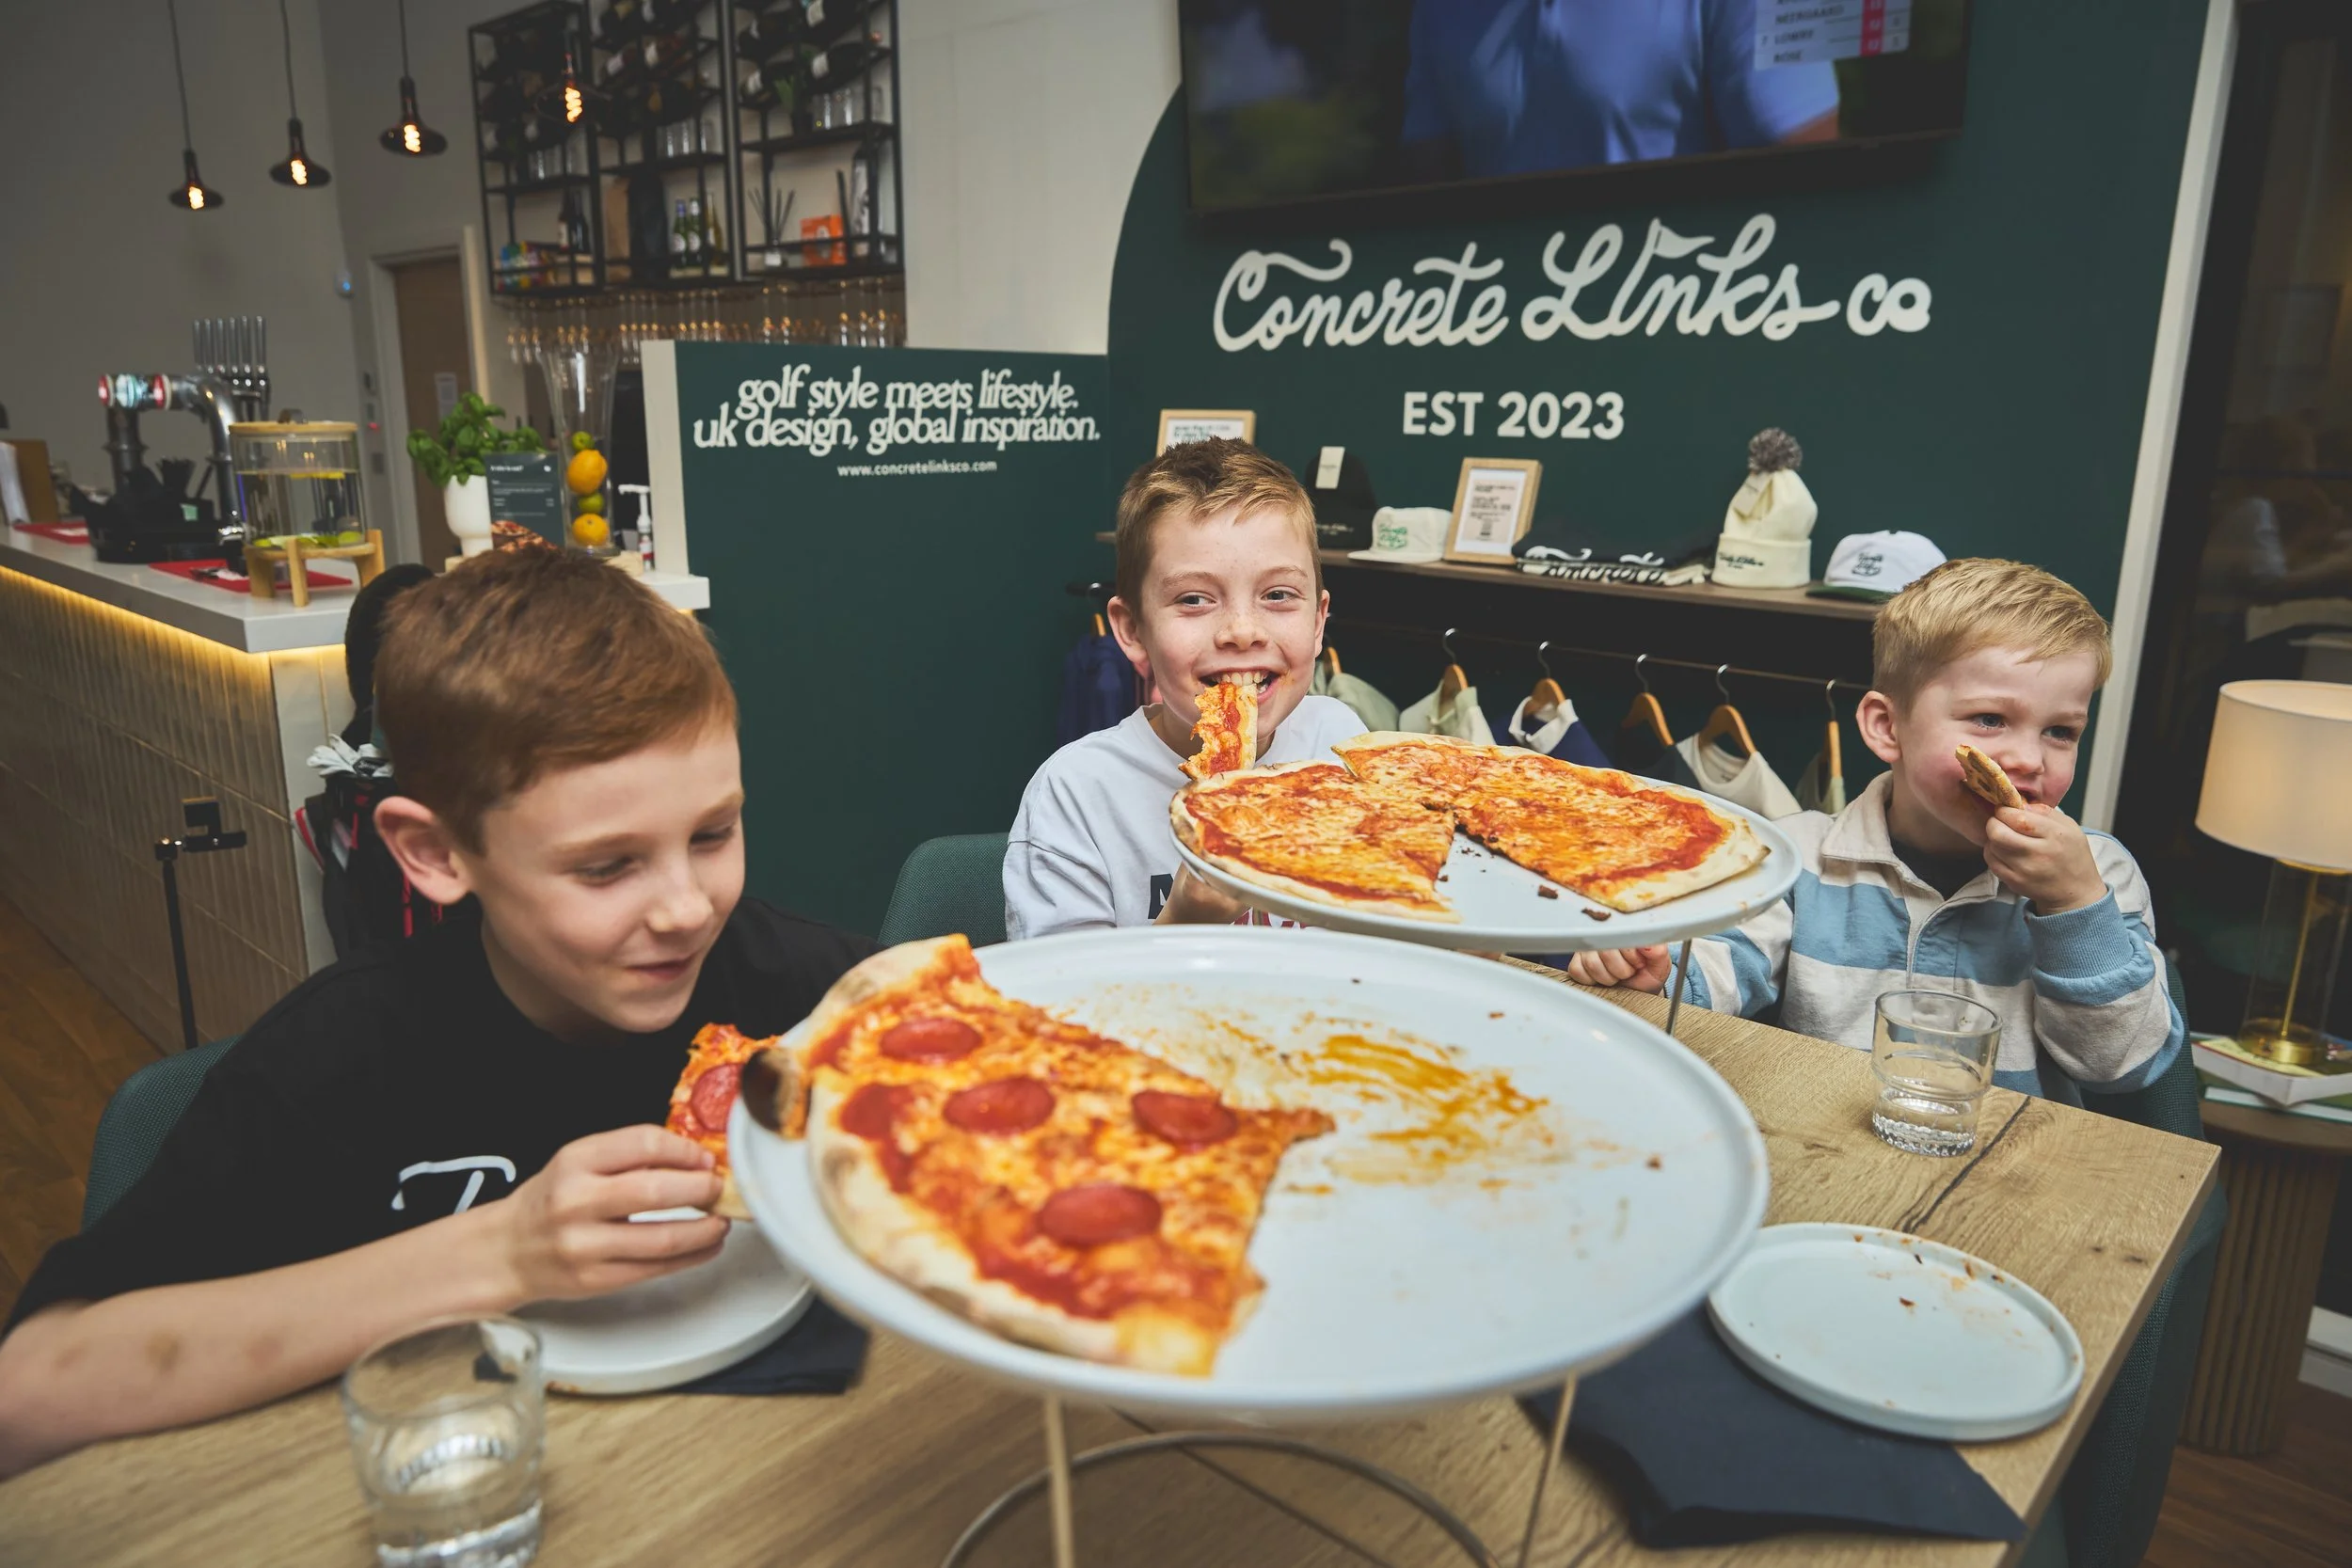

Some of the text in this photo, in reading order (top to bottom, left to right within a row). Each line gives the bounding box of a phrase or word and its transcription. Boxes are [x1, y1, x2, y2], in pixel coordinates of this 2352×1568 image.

[1214, 239, 1508, 352] Concrete
[1521, 213, 1841, 341] Links
[735, 363, 1079, 420] golf style meets lifestyle.
[1403, 390, 1625, 440] EST 2023
[693, 399, 1101, 457] uk design, global inspiration.
[836, 458, 998, 477] www.concretelinksco.com
